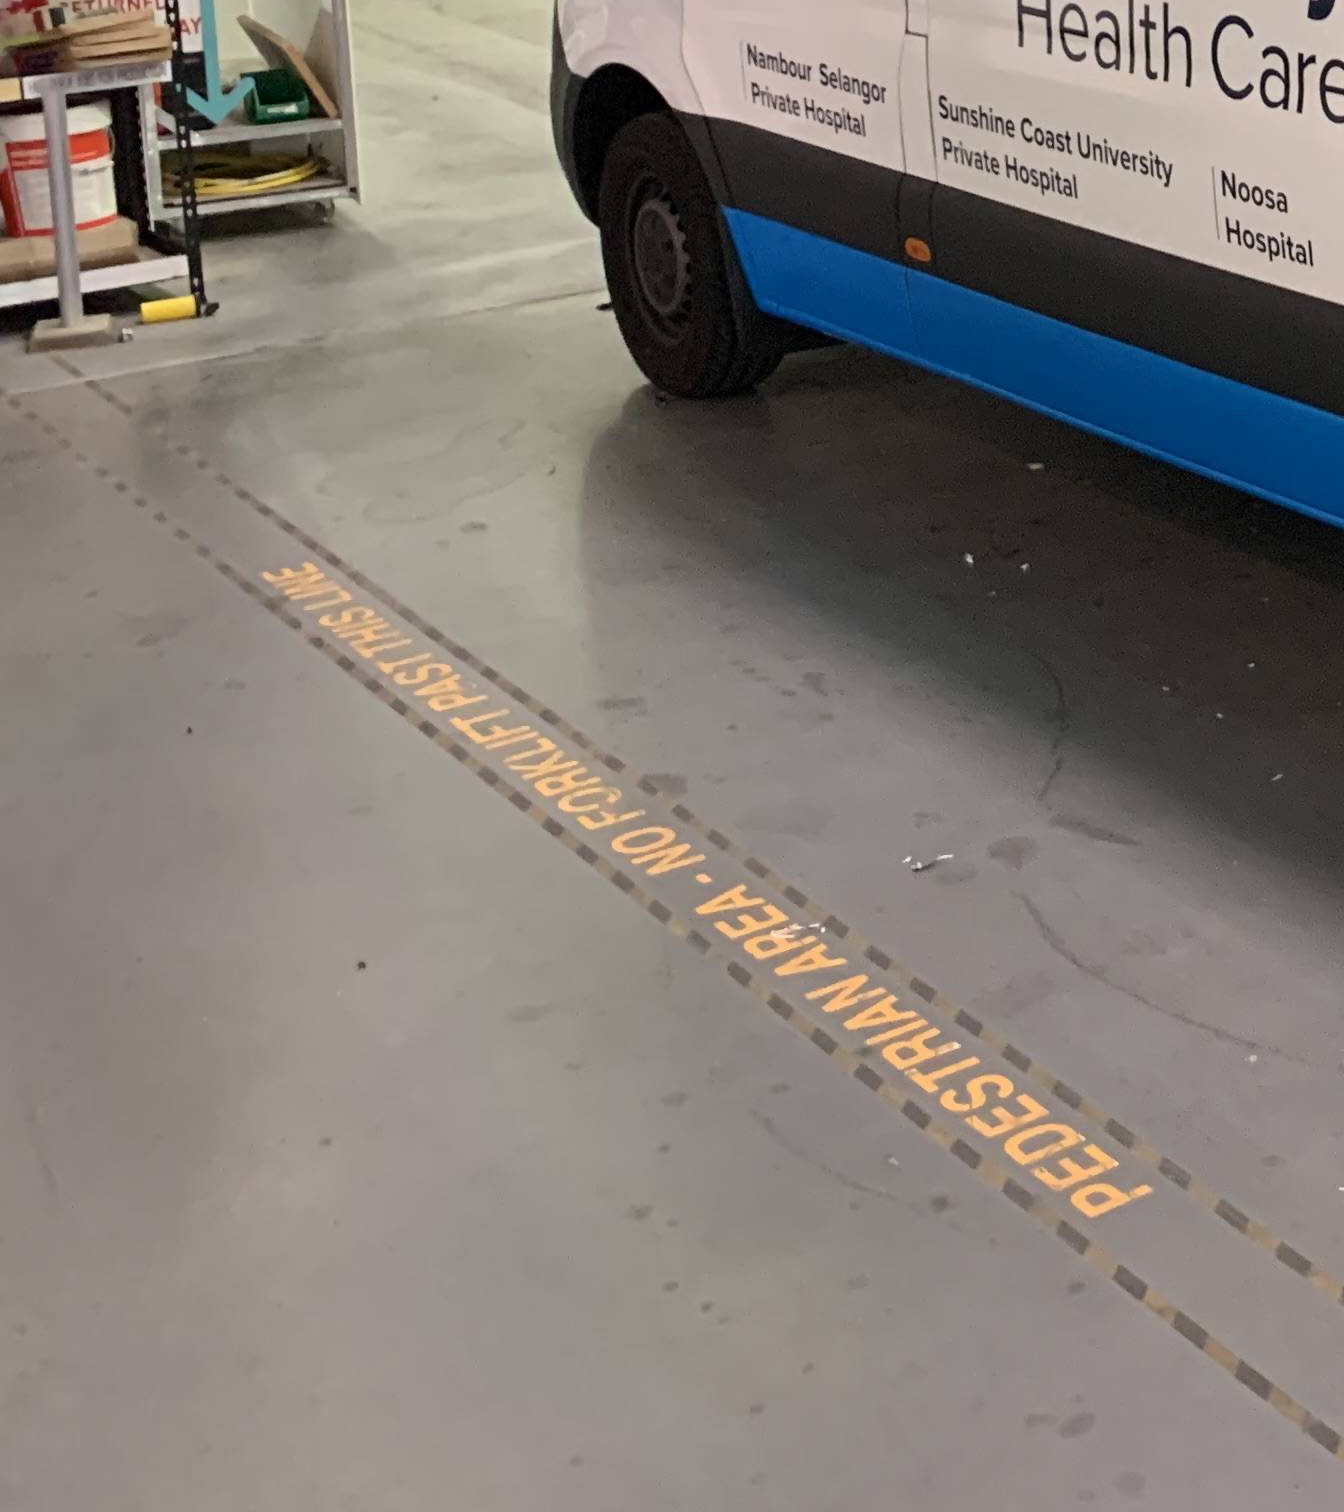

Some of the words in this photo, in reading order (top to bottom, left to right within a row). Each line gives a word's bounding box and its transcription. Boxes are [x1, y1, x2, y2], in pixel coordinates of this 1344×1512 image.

[746, 43, 812, 82] Nambour
[818, 63, 887, 105] Selangor
[750, 81, 801, 117] Private
[803, 97, 866, 137] Hospital
[938, 94, 1016, 138] Sunshine
[1020, 117, 1073, 155] Coast
[1076, 132, 1173, 188] University
[941, 136, 1000, 176] Private
[1004, 154, 1078, 199] Hospital
[1221, 170, 1288, 214] Noosa
[1225, 216, 1314, 267] Hospital
[262, 561, 353, 611] LINE
[318, 606, 412, 659] THIS
[375, 652, 488, 712] PAST
[450, 709, 646, 831] FORKLIFT
[610, 826, 706, 877] NO
[695, 884, 848, 977] AREA
[804, 973, 1153, 1221] PEDESTRIAN
